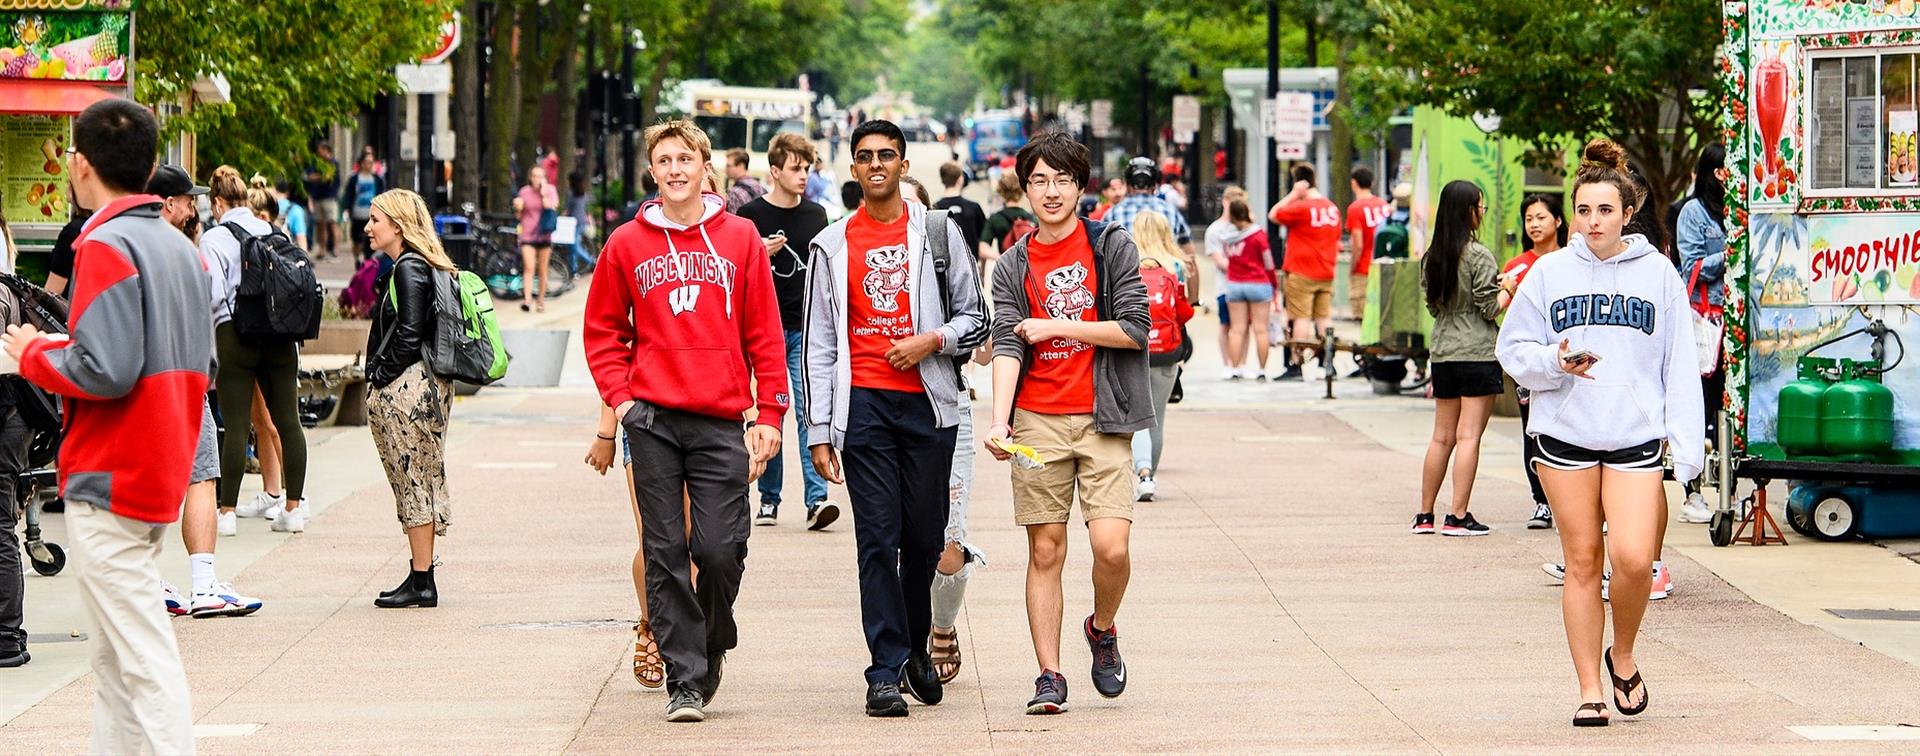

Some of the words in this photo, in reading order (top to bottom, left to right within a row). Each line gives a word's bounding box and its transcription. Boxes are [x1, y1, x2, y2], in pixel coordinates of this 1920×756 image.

[634, 251, 738, 298] WISCONSIN
[669, 284, 700, 317] W
[899, 313, 909, 323] of
[1550, 293, 1655, 336] CHICAGO
